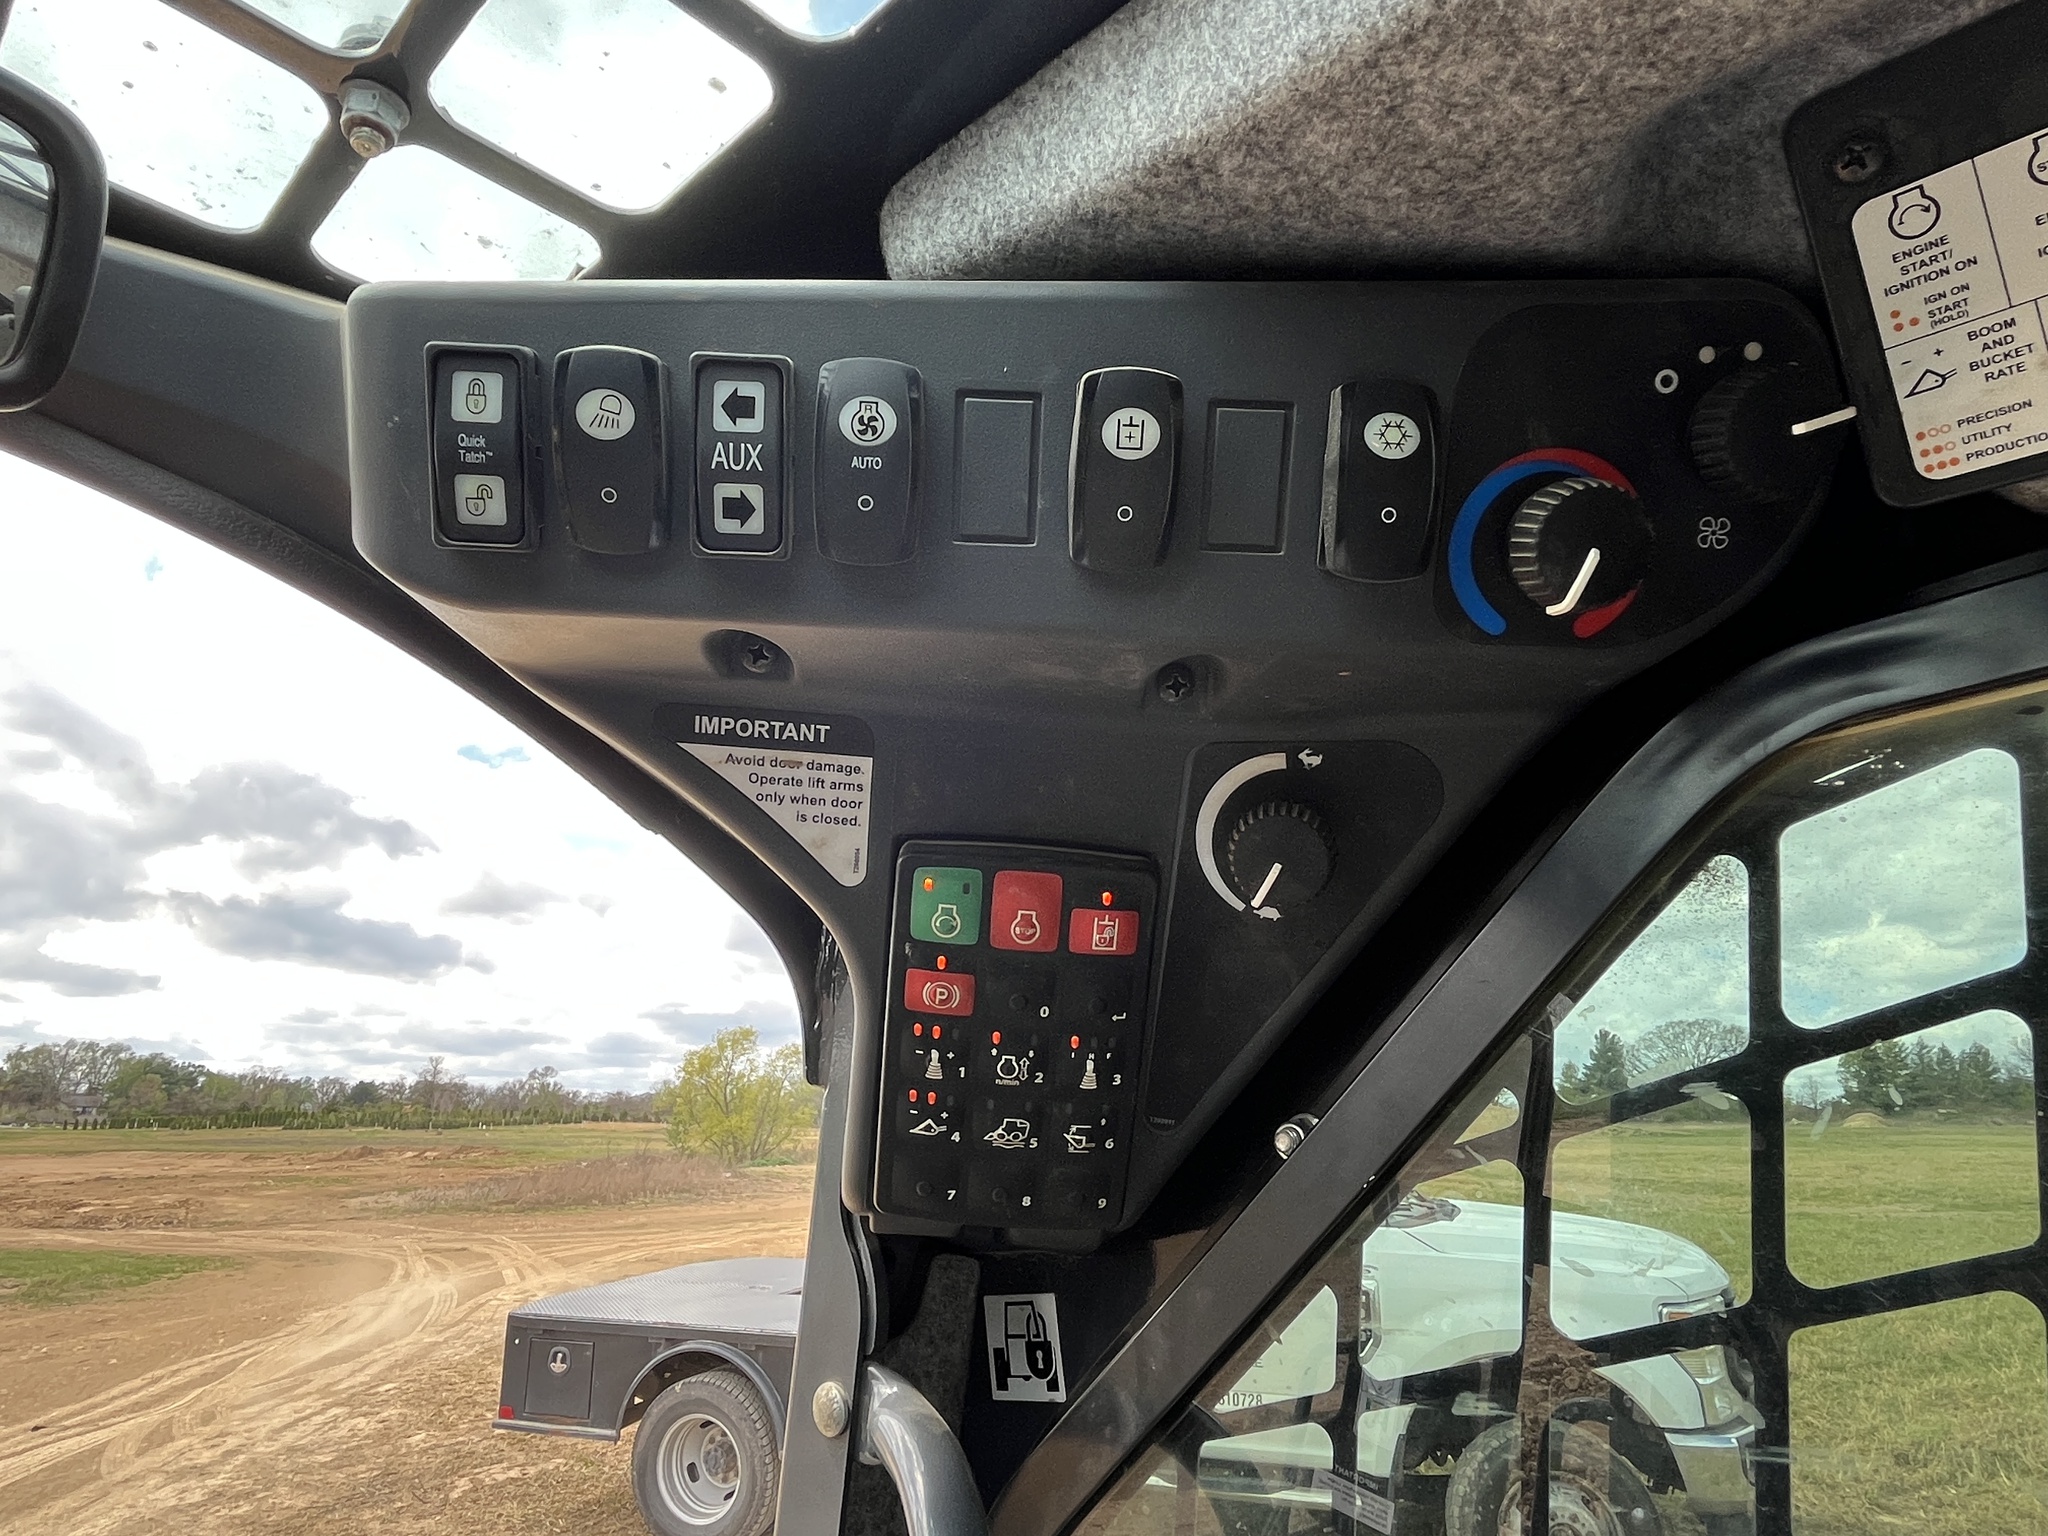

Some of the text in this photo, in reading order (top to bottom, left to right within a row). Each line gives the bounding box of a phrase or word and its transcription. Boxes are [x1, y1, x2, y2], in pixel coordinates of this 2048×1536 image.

[1892, 234, 1950, 264] ENGINE
[1900, 248, 1954, 276] START/
[1884, 255, 1978, 298] IGNITION ON
[1924, 282, 1970, 306] IGN ON
[1927, 298, 1970, 319] START
[1930, 309, 1970, 330] (HOLD)
[1967, 317, 2017, 341] BOOM
[1981, 333, 2015, 353] AND
[1969, 342, 2035, 372] BUCKET
[1985, 361, 2028, 383] RATE
[1957, 398, 2033, 428] PRECISION
[457, 434, 486, 450] Quick
[1961, 422, 2013, 446] UTILITY
[711, 442, 764, 473] AUX
[851, 456, 882, 470] AUTO
[694, 715, 831, 743] IMPORTANT
[724, 753, 765, 768] Avoid
[806, 759, 866, 776] damage.
[748, 772, 864, 792] Operate lift arms
[756, 791, 863, 810] only when door
[796, 811, 861, 827] is closed.
[1015, 926, 1036, 936] STOP
[1040, 1006, 1050, 1018] 0
[958, 1066, 966, 1078] 1
[1034, 1072, 1044, 1083] 2
[1113, 1074, 1121, 1085] 3
[951, 1131, 961, 1143] 4
[1029, 1138, 1038, 1148] 5
[1105, 1139, 1114, 1149] 6
[948, 1190, 956, 1200] 7
[1022, 1196, 1031, 1207] 8
[1098, 1198, 1106, 1209] 9
